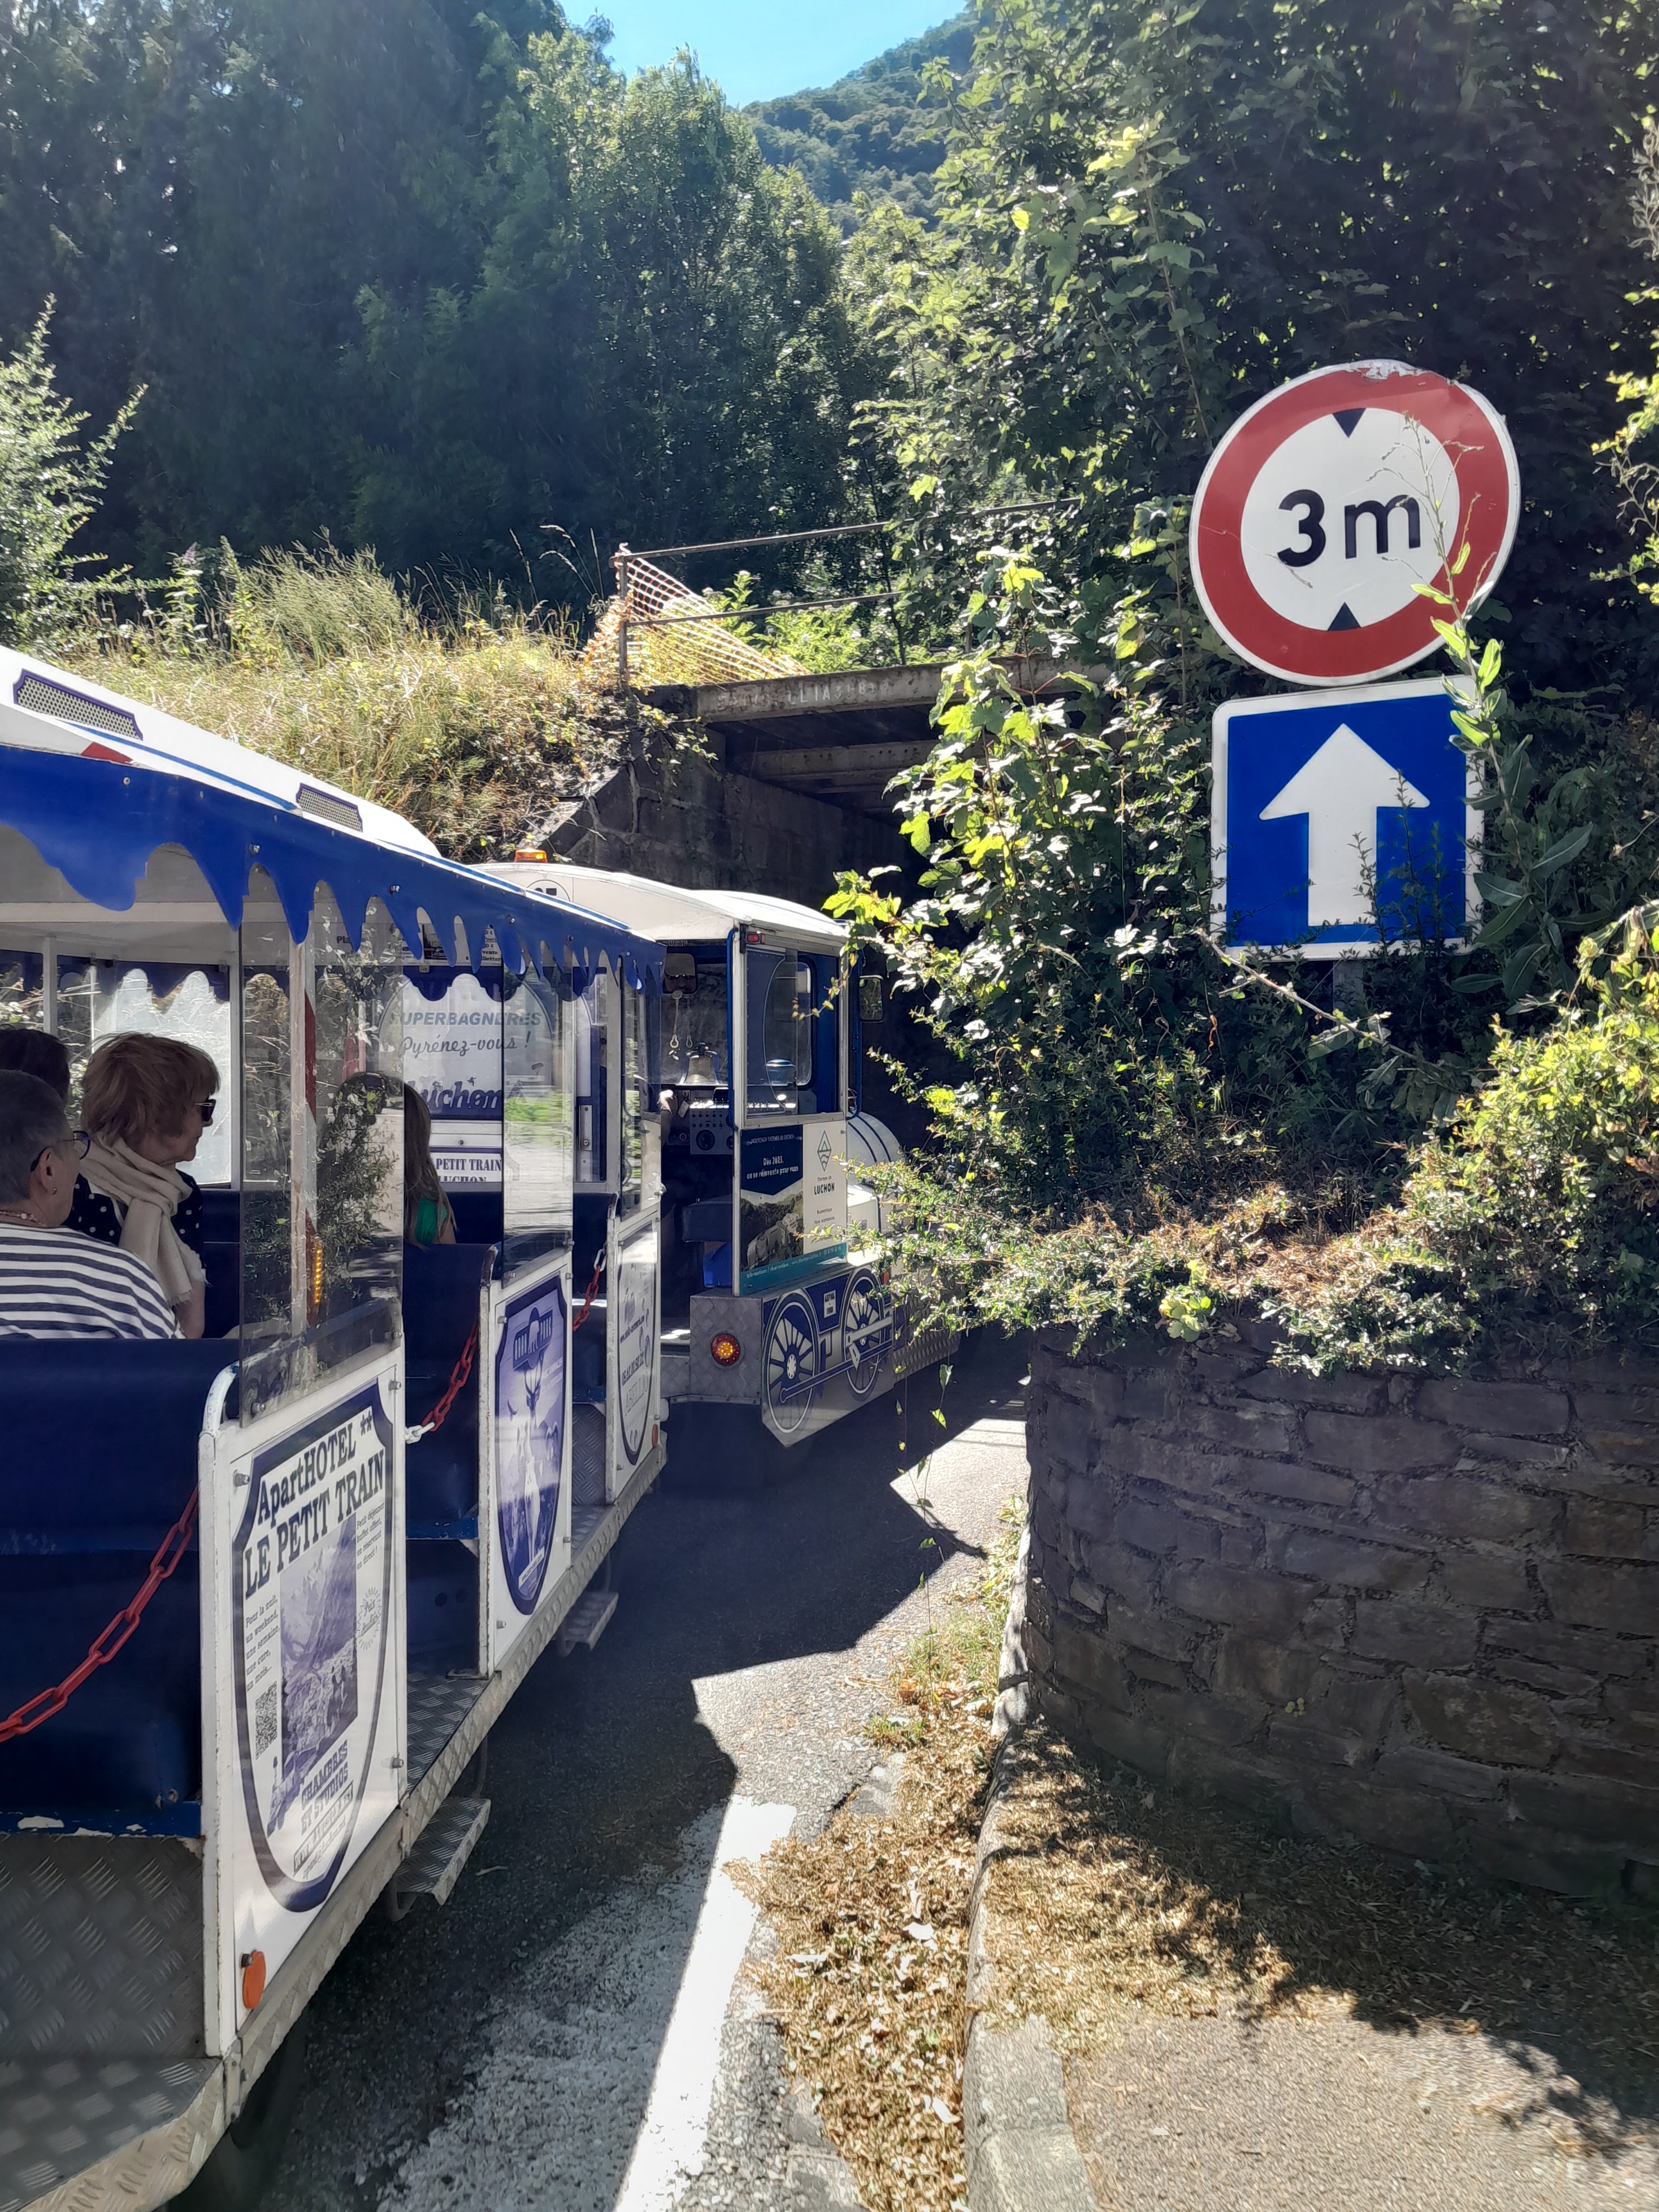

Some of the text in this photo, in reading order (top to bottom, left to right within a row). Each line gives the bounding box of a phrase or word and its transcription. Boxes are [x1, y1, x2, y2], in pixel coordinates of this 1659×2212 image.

[1277, 489, 1421, 568] 3 m
[436, 1158, 501, 1171] PETIT TRAIN
[814, 1182, 834, 1195] LUCHON
[258, 1422, 356, 1530] ApartHOTEL
[245, 1448, 384, 1600] LE PETIT TRAIN
[246, 1594, 278, 1628] Pour la nuit,
[246, 1632, 253, 1644] un
[246, 1646, 256, 1660] une
[246, 1649, 271, 1676] une cure,
[247, 1681, 253, 1692] un
[301, 1739, 348, 1812] CHAMBRES
[301, 1761, 348, 1836] ET STUDIOS
